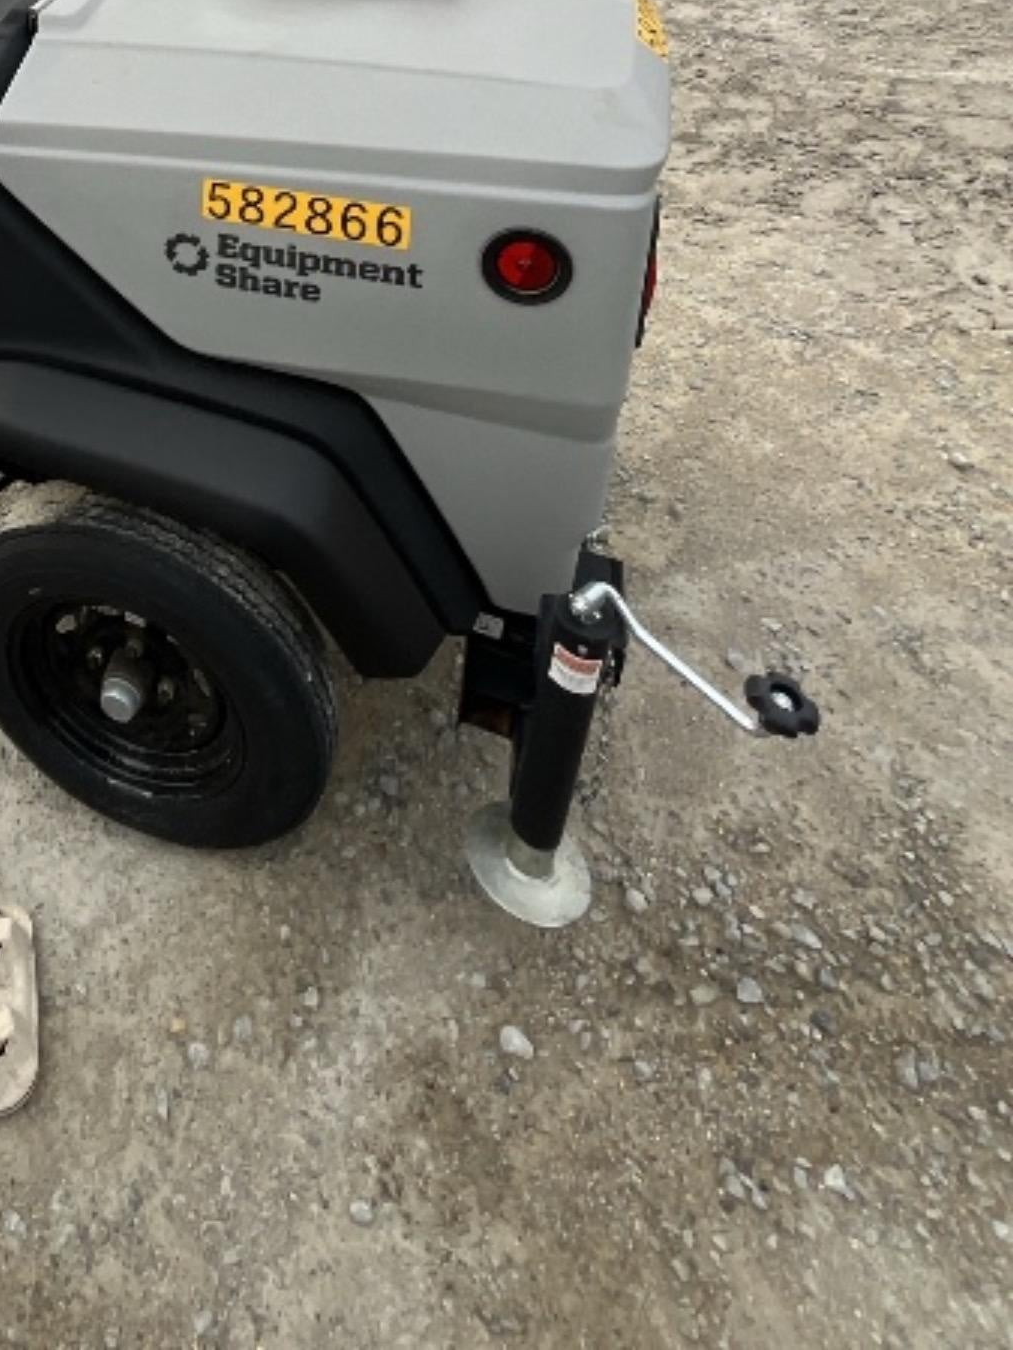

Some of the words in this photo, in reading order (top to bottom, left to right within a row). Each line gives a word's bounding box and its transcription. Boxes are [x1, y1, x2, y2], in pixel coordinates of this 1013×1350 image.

[207, 182, 404, 247] 582866
[214, 263, 322, 302] Share
[217, 233, 424, 289] Equipment
